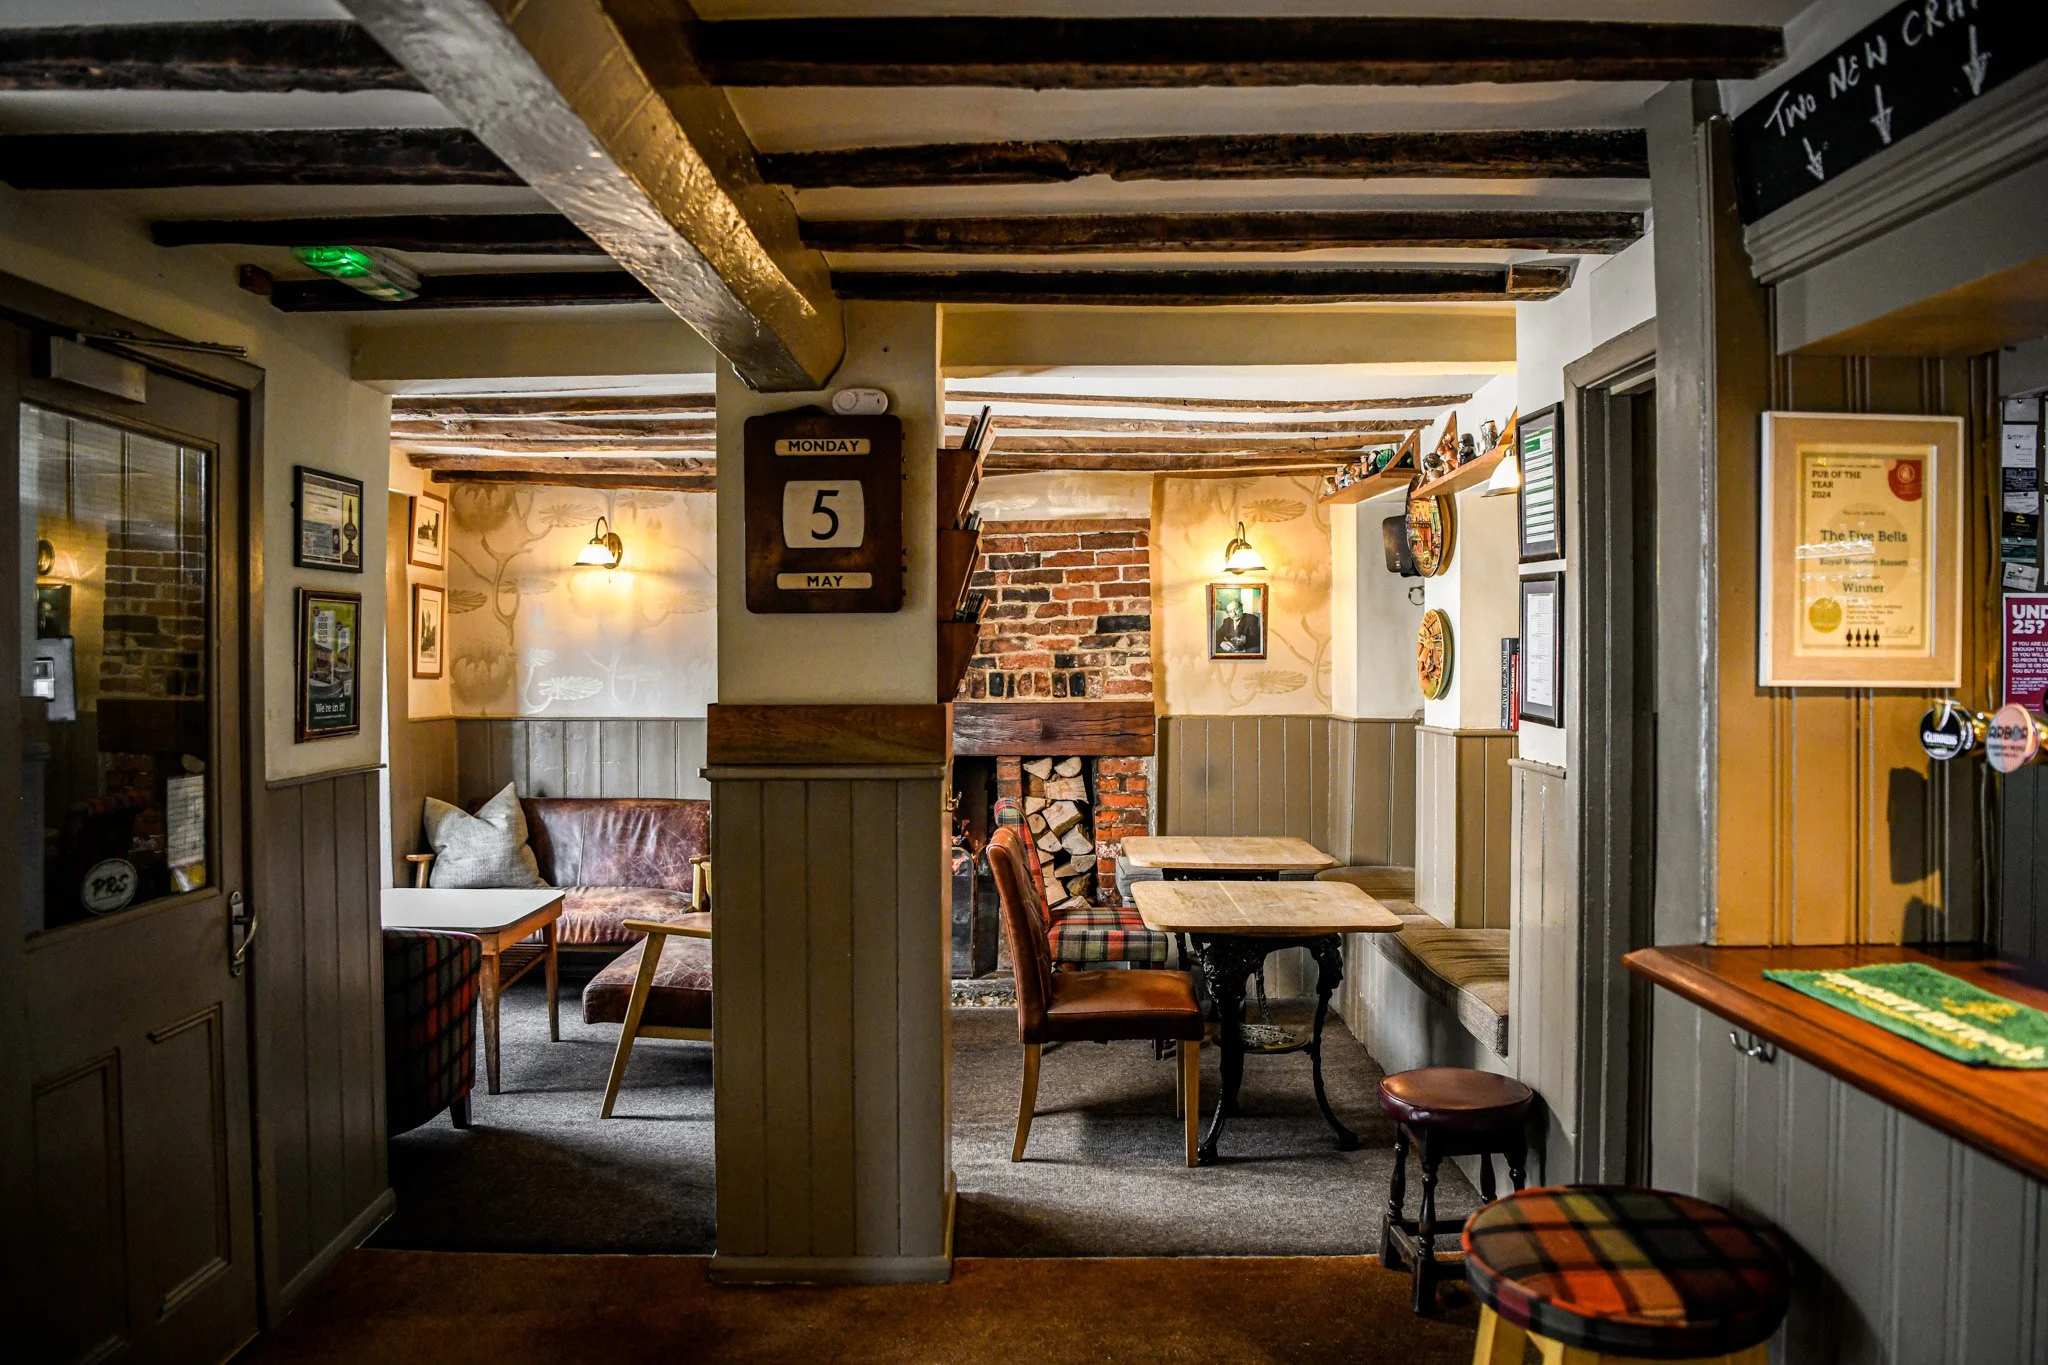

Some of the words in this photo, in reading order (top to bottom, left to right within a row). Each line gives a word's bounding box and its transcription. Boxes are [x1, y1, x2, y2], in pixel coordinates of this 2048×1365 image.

[1764, 90, 1817, 137] TWO
[1828, 34, 1888, 99] NEW
[788, 440, 860, 452] MONDAY
[1811, 470, 1829, 478] PUB
[1831, 470, 1842, 478] OF
[1844, 471, 1862, 479] THE
[1811, 480, 1834, 488] YEAR
[811, 489, 840, 540] 5
[1820, 529, 1846, 542] The
[1878, 530, 1908, 542] Bells
[807, 575, 843, 587] MAY
[1843, 582, 1884, 593] Winner
[2012, 619, 2046, 634] 25?
[91, 873, 129, 897] PRS
